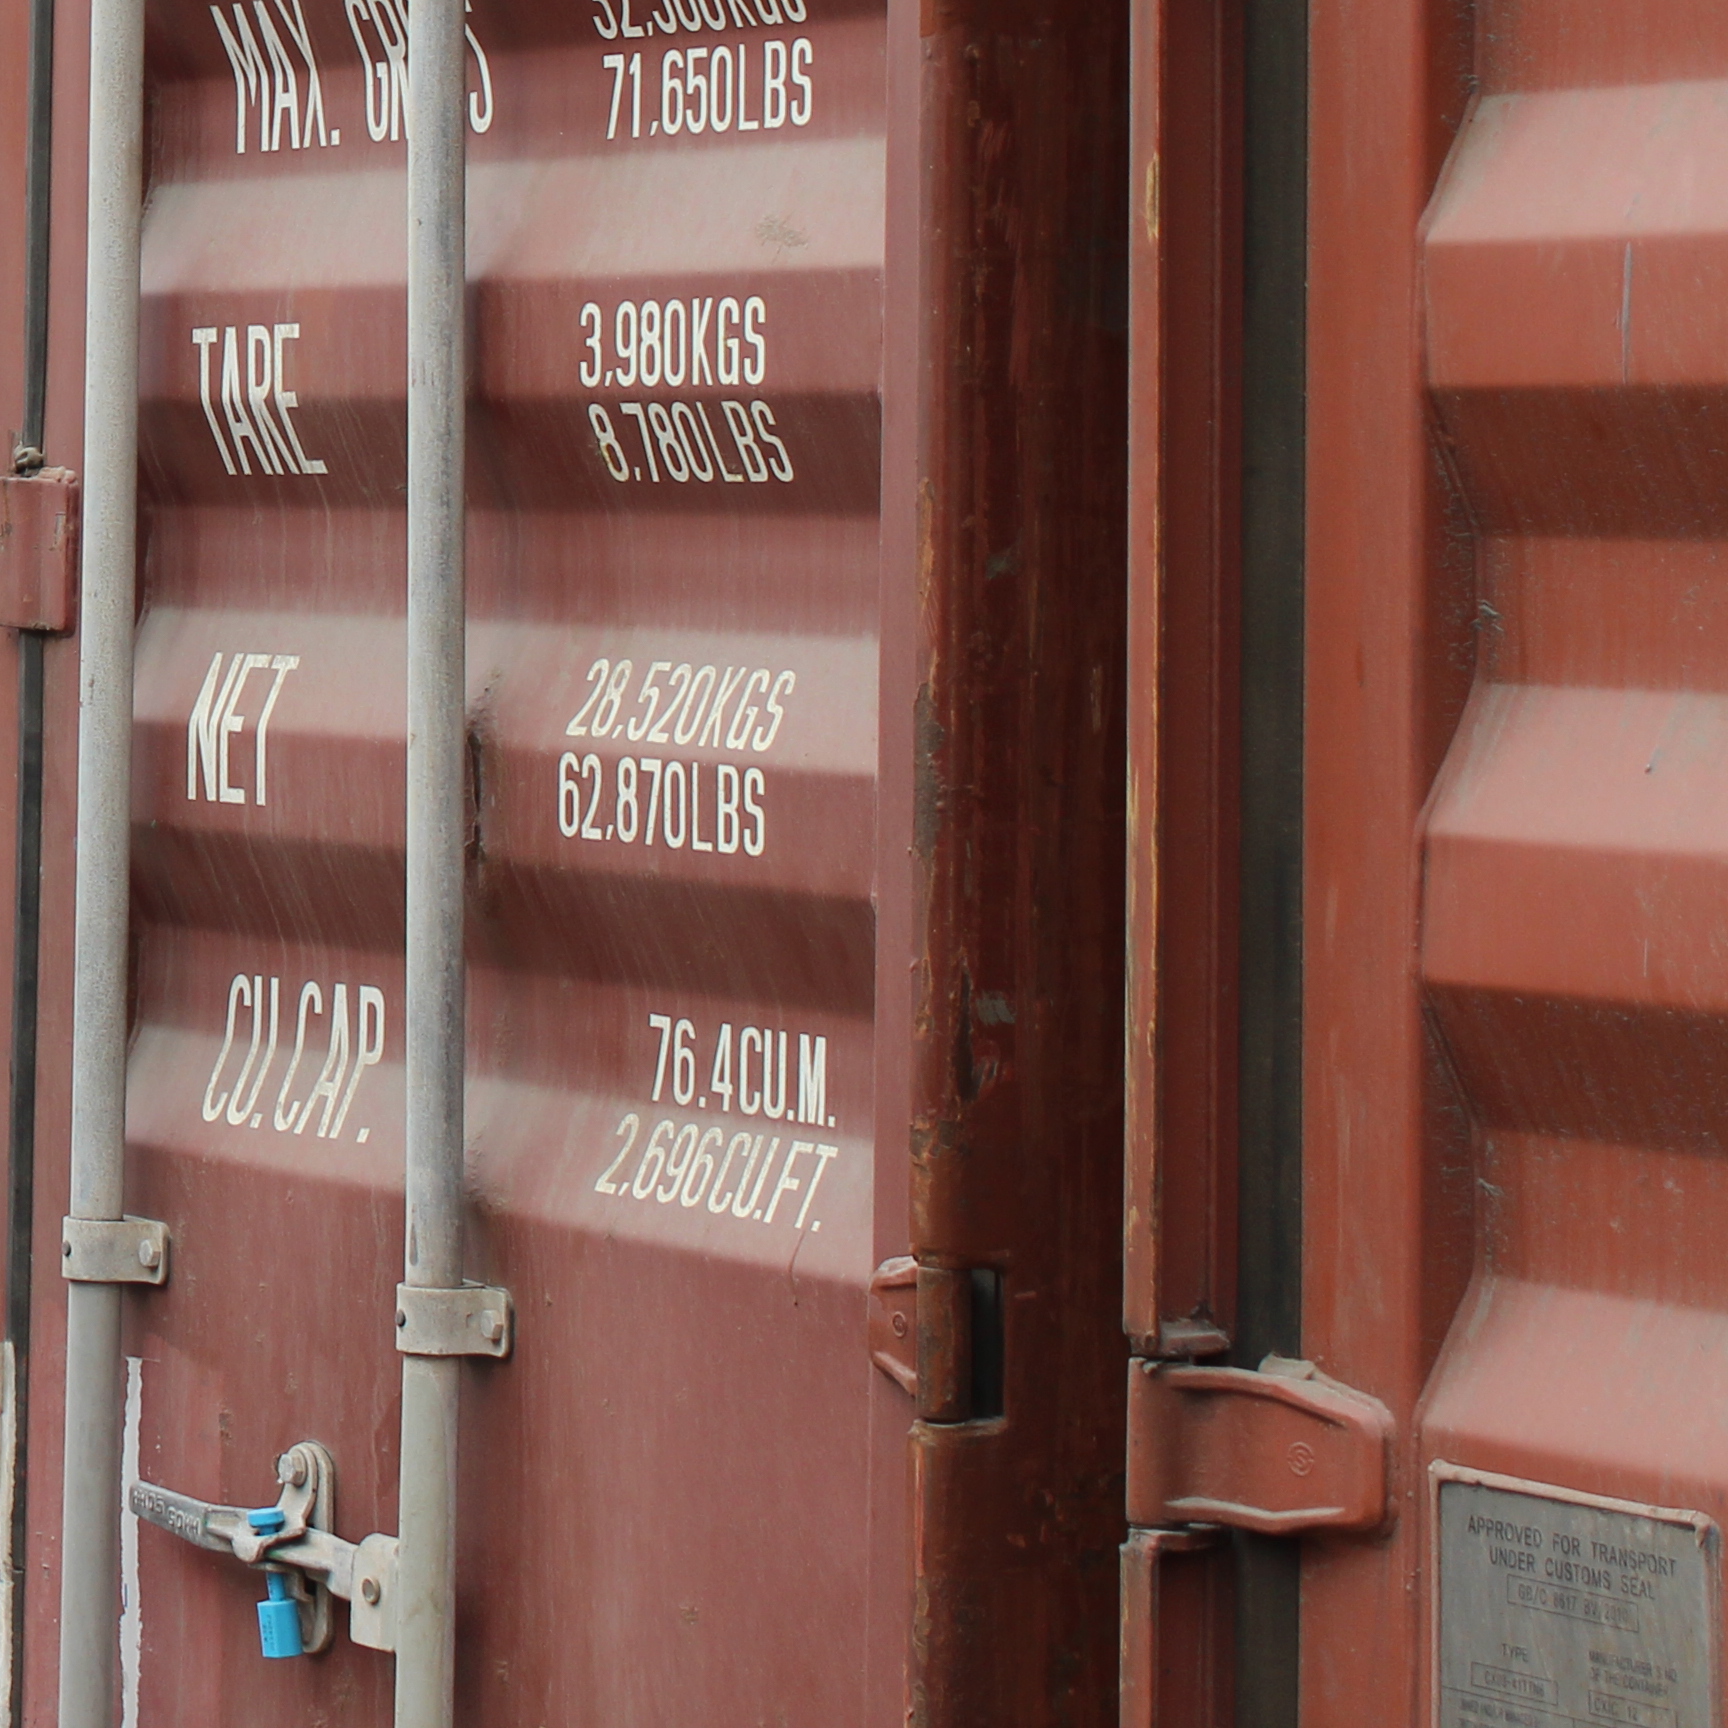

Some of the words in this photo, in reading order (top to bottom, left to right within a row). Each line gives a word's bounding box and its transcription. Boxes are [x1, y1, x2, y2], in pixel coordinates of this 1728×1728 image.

[193, 323, 329, 476] TARE
[188, 652, 299, 806] NET
[1468, 1515, 1542, 1548] APPROVED
[1553, 1533, 1581, 1556] FOR
[1591, 1541, 1676, 1577] TRANSPORT
[1489, 1546, 1535, 1573] UNDER
[1546, 1557, 1611, 1591] CUSTOMS
[1621, 1578, 1655, 1600] SEAL
[1501, 1643, 1528, 1662] TYPE
